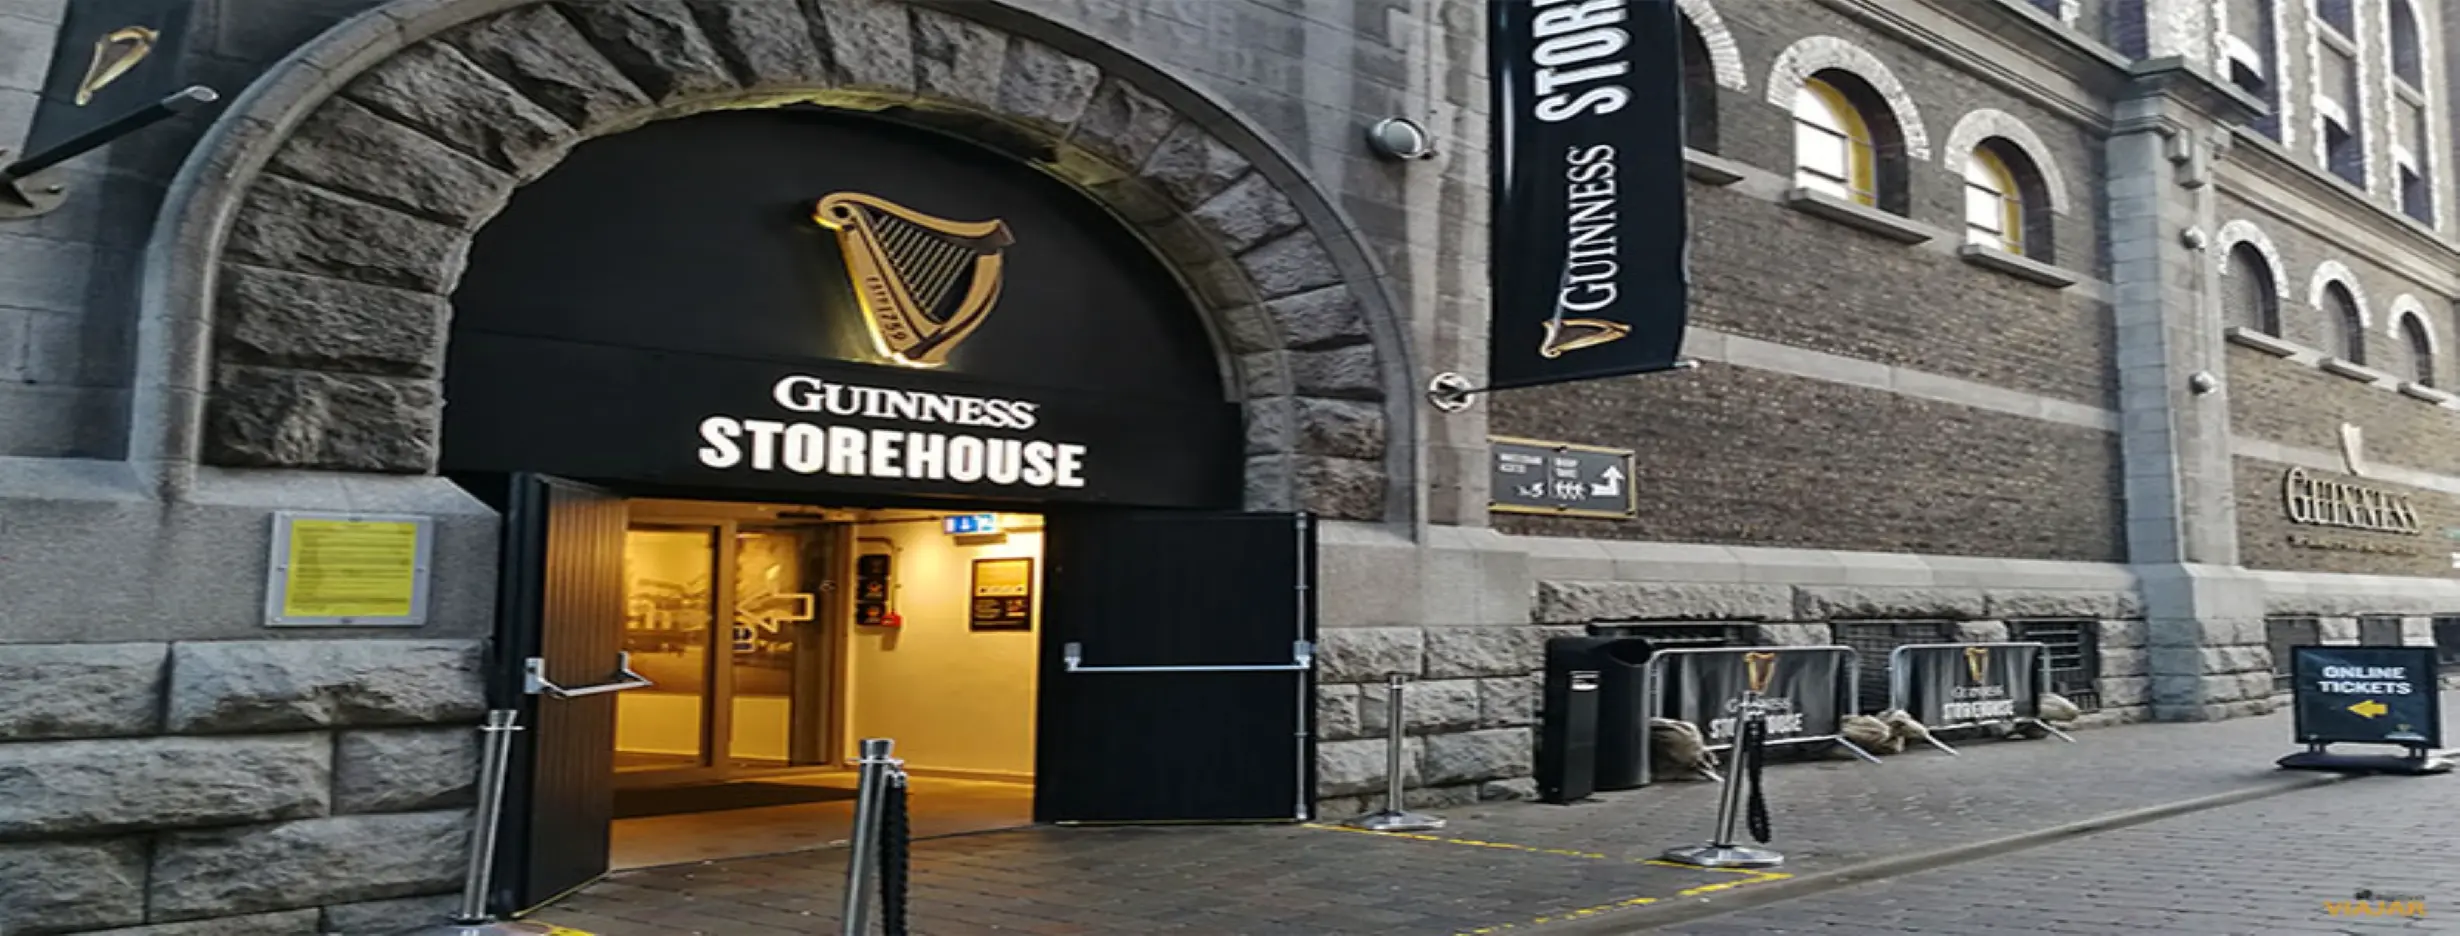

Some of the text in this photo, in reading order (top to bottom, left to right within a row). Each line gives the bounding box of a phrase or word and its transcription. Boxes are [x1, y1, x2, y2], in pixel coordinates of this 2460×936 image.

[1532, 0, 1632, 312] GUINNESS STOR
[774, 375, 1040, 430] GUINNESS
[699, 416, 1087, 487] STOREHOUSE
[2317, 680, 2413, 695] TICKETS
[2321, 665, 2407, 680] ONLINE
